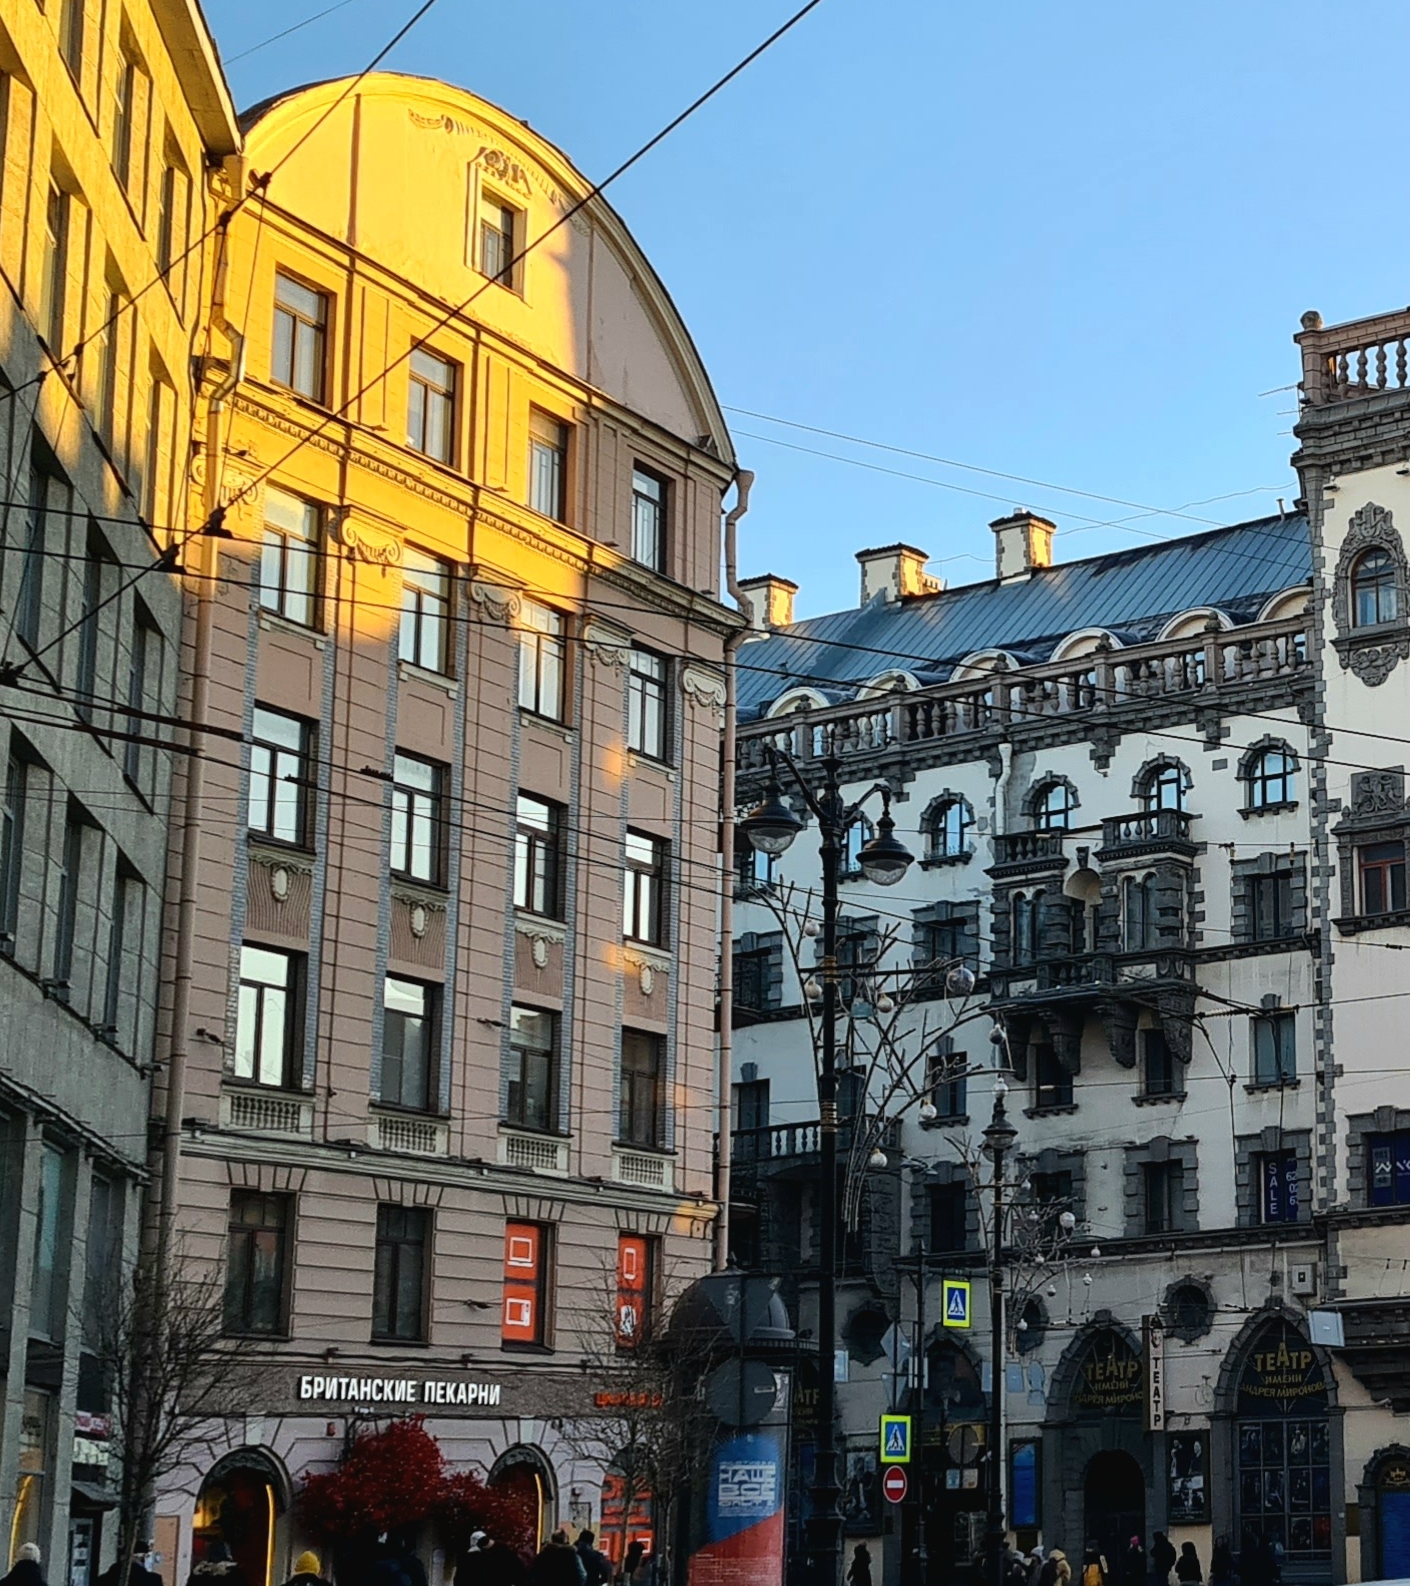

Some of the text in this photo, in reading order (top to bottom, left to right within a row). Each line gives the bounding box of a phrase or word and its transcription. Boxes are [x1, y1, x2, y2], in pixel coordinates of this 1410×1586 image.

[1268, 1162, 1278, 1214] SALE
[1085, 1355, 1138, 1380] ТЕАТР
[1254, 1342, 1312, 1372] ТЕАТР
[300, 1376, 500, 1405] БРИТАНСКИЕ ПЕКАРНИ
[1153, 1357, 1161, 1426] ТЕАТР
[1265, 1374, 1302, 1385] ИМЕНИ
